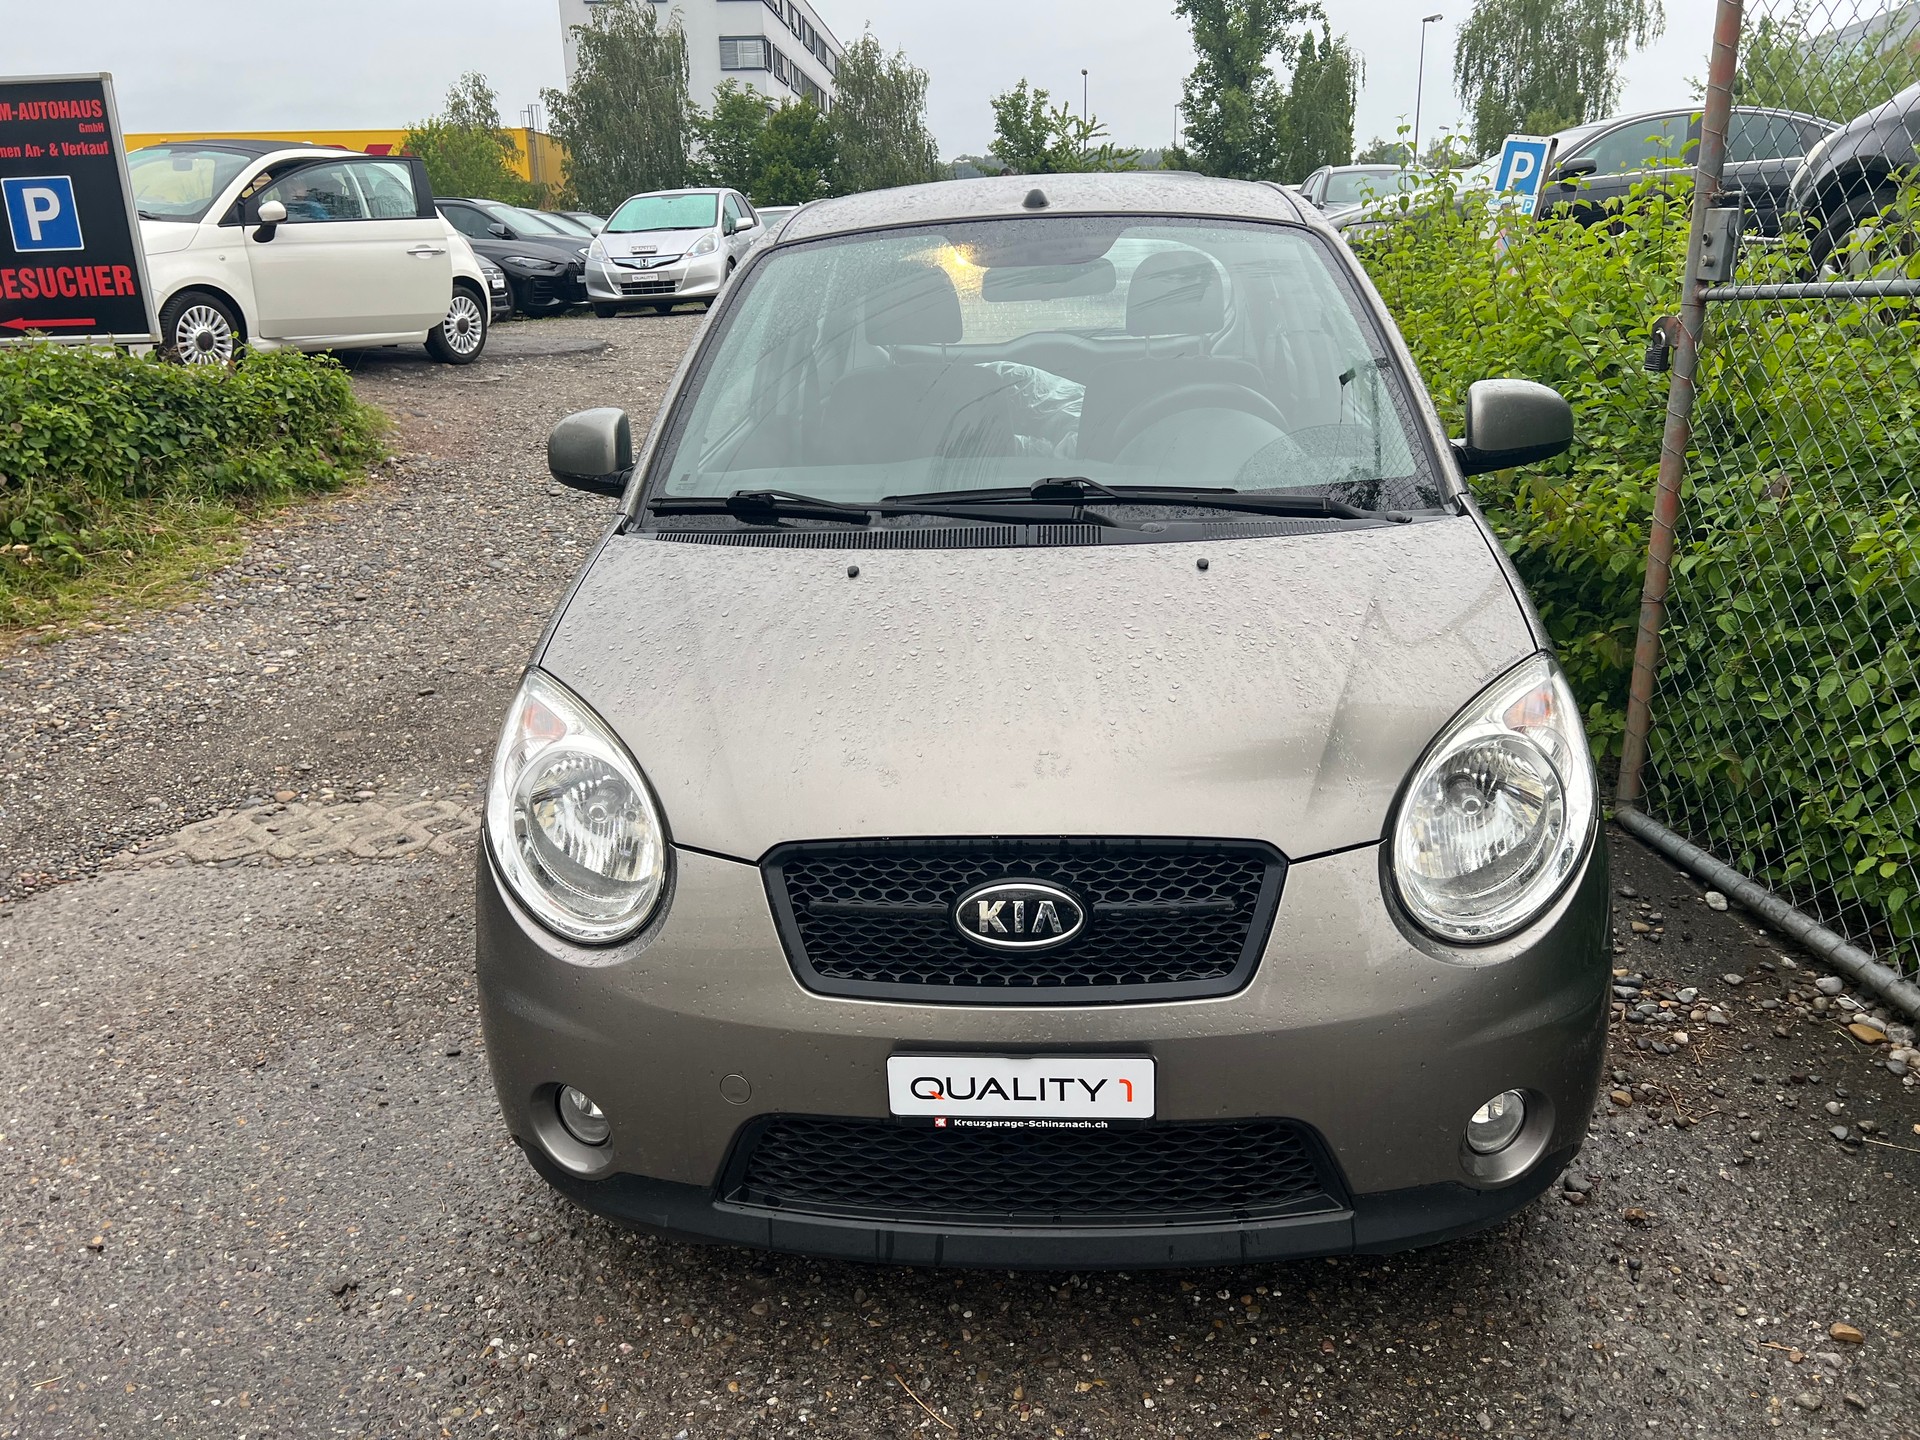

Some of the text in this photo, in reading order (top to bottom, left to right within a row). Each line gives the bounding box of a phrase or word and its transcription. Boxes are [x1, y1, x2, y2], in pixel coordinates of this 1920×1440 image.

[78, 122, 105, 133] GmbH
[25, 143, 45, 158] An-
[49, 142, 59, 156] &
[61, 140, 109, 156] Verkauf
[1504, 151, 1535, 191] P
[22, 187, 61, 241] P
[1523, 201, 1532, 212] P
[0, 264, 135, 300] ESUCHER
[1478, 671, 1495, 684] Auto
[977, 900, 1063, 933] KIA
[910, 1076, 1133, 1102] QUALITY 1
[953, 1118, 1108, 1129] Kreuzgarage-Schinznach.ch
